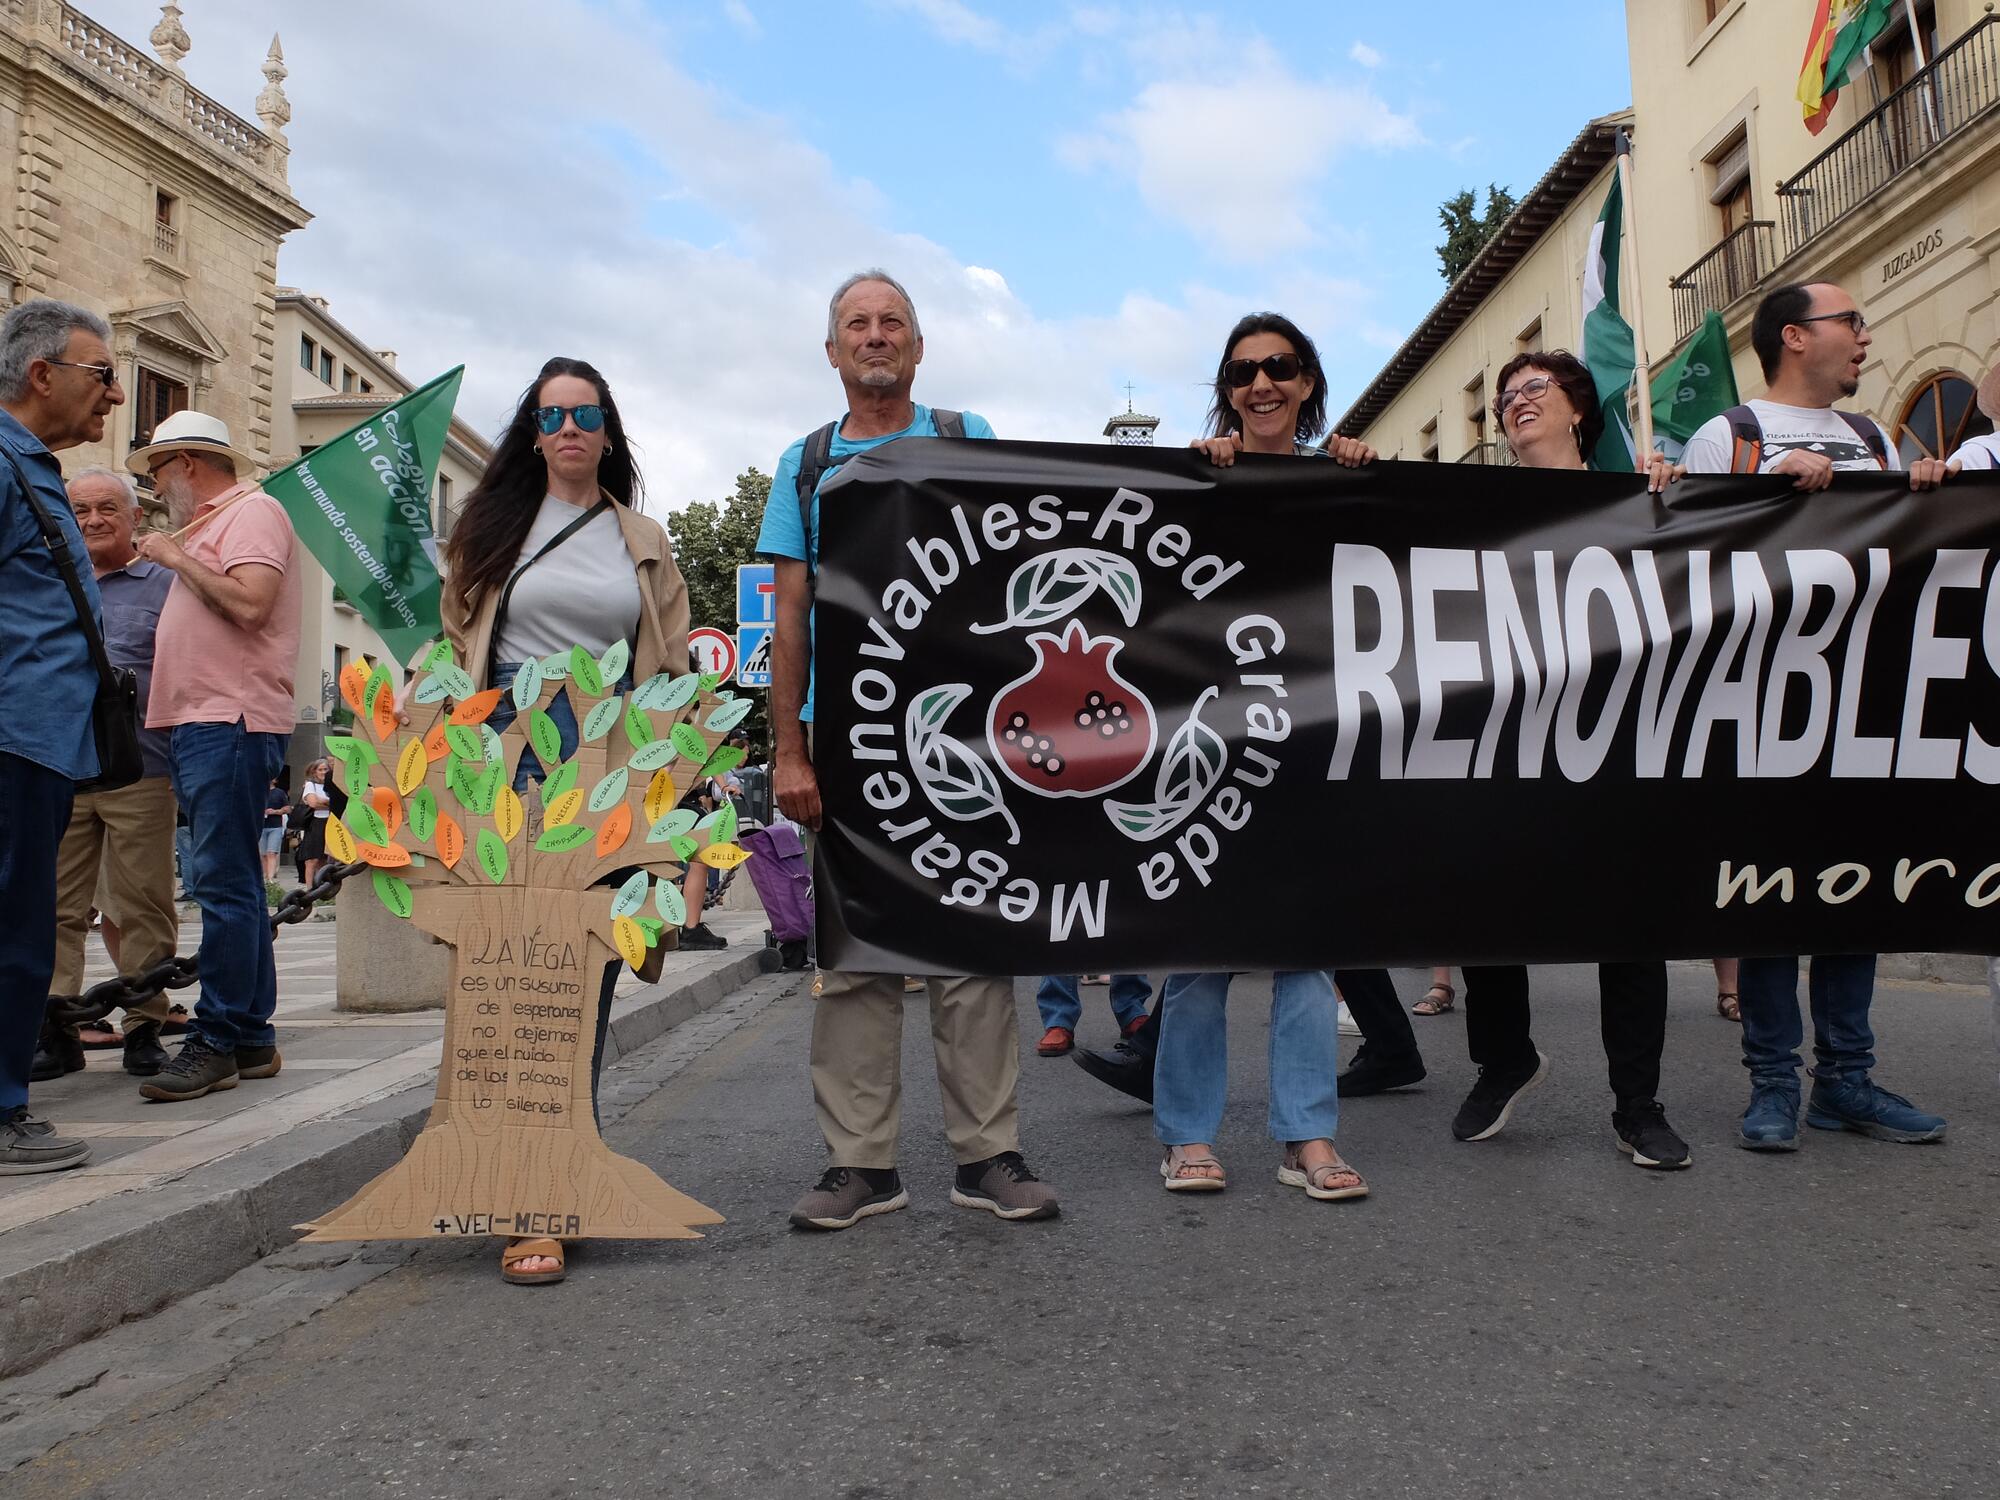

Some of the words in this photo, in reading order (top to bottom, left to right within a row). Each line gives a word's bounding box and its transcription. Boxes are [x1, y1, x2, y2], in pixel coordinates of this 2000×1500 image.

[1882, 228, 1943, 283] JUZGADOS
[295, 460, 311, 478] Por
[302, 473, 318, 490] un
[354, 427, 379, 453] en
[370, 454, 430, 533] acción
[310, 487, 346, 528] mundo
[339, 526, 394, 592] sostenible
[384, 588, 401, 600] y
[391, 595, 417, 629] justo
[545, 666, 568, 676] FAUNA
[604, 655, 619, 678] FLORES
[366, 676, 381, 708] CONFORT
[521, 663, 534, 707] RENOVACIÓN
[587, 701, 612, 738] NUTRICIÓN
[456, 729, 476, 760] TRABAJO
[635, 742, 671, 765] PAISAJE
[674, 727, 704, 758] REFUGIO
[1137, 613, 1293, 901] Granada
[593, 768, 625, 809] RECREACIÓN
[419, 799, 427, 836] COMUNIDAD
[551, 791, 579, 826] VARIEDAD
[655, 820, 679, 836] VIDA
[364, 847, 407, 863] TRADICIÓN
[617, 880, 644, 913] ALIMENTO
[663, 883, 679, 921] SUSTENTO
[472, 927, 514, 966] LA
[461, 975, 489, 992] es
[495, 976, 516, 991] un
[519, 977, 580, 995] susurro
[476, 998, 500, 1016] de
[472, 1025, 497, 1039] no
[514, 1023, 579, 1045] dejemos
[457, 1048, 488, 1064] que
[494, 1045, 510, 1060] el
[513, 1046, 556, 1062] ruido
[456, 1067, 478, 1081] de
[518, 1068, 569, 1087] placas
[506, 1095, 563, 1114] silencie
